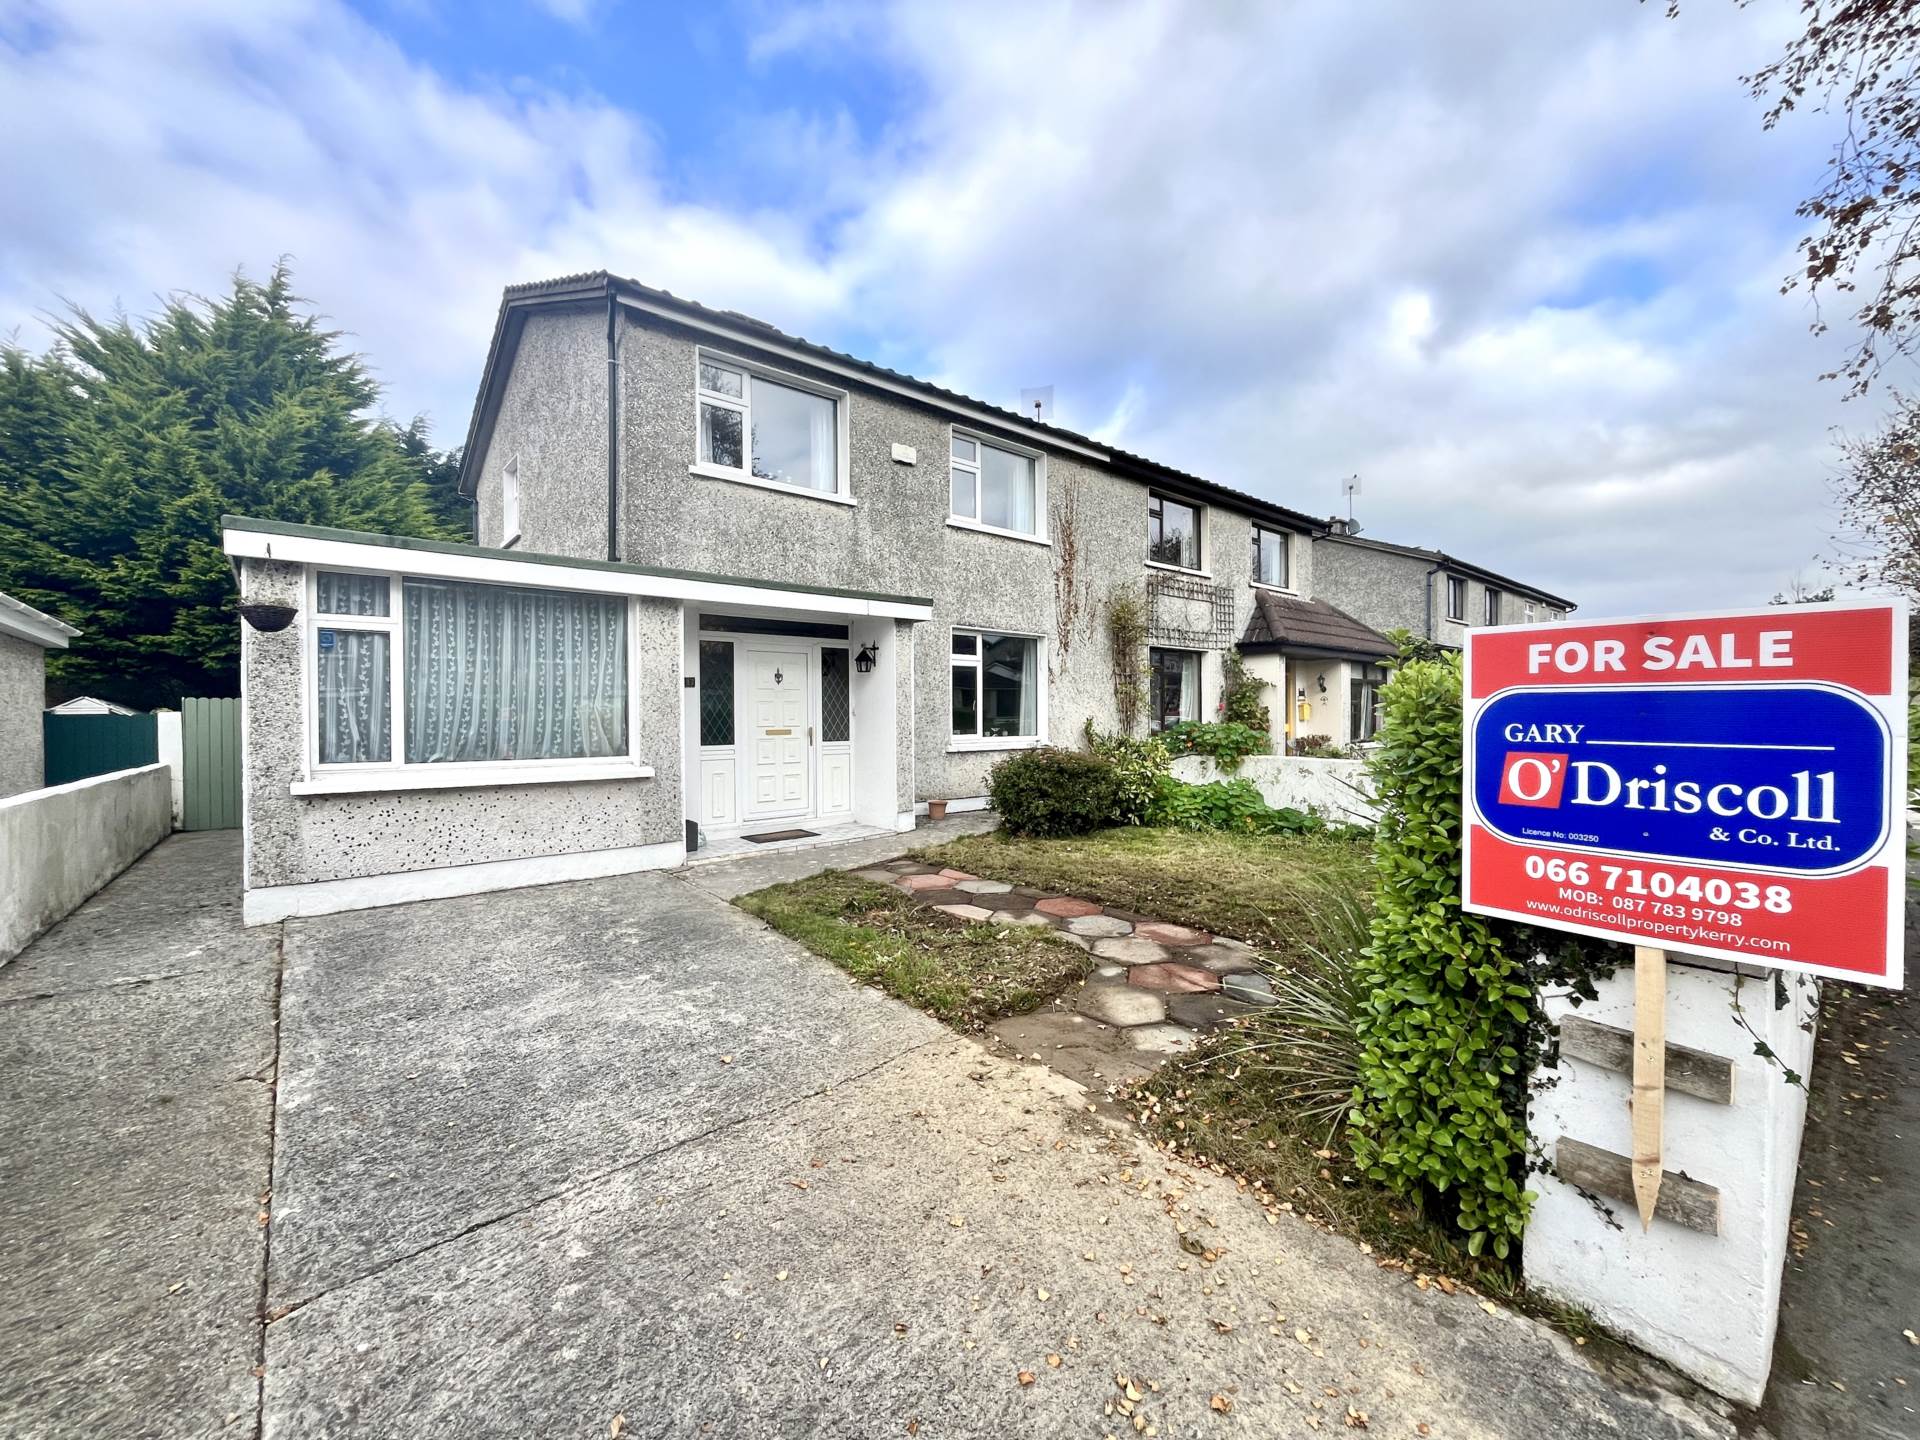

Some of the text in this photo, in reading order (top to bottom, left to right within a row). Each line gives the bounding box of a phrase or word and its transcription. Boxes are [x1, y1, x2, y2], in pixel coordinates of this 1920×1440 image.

[1528, 630, 1794, 674] FOR SALE
[1504, 723, 1585, 744] GARY
[1508, 758, 1841, 824] O'Driscoll
[1522, 827, 1599, 842] Licence No: 003250
[1709, 827, 1841, 851] & Co. Ltd.
[1525, 855, 1792, 914] 066 7104038
[1526, 900, 1791, 951] www.odriscollpropertykerry.com
[1558, 887, 1742, 926] MOB: 087 783 9798
